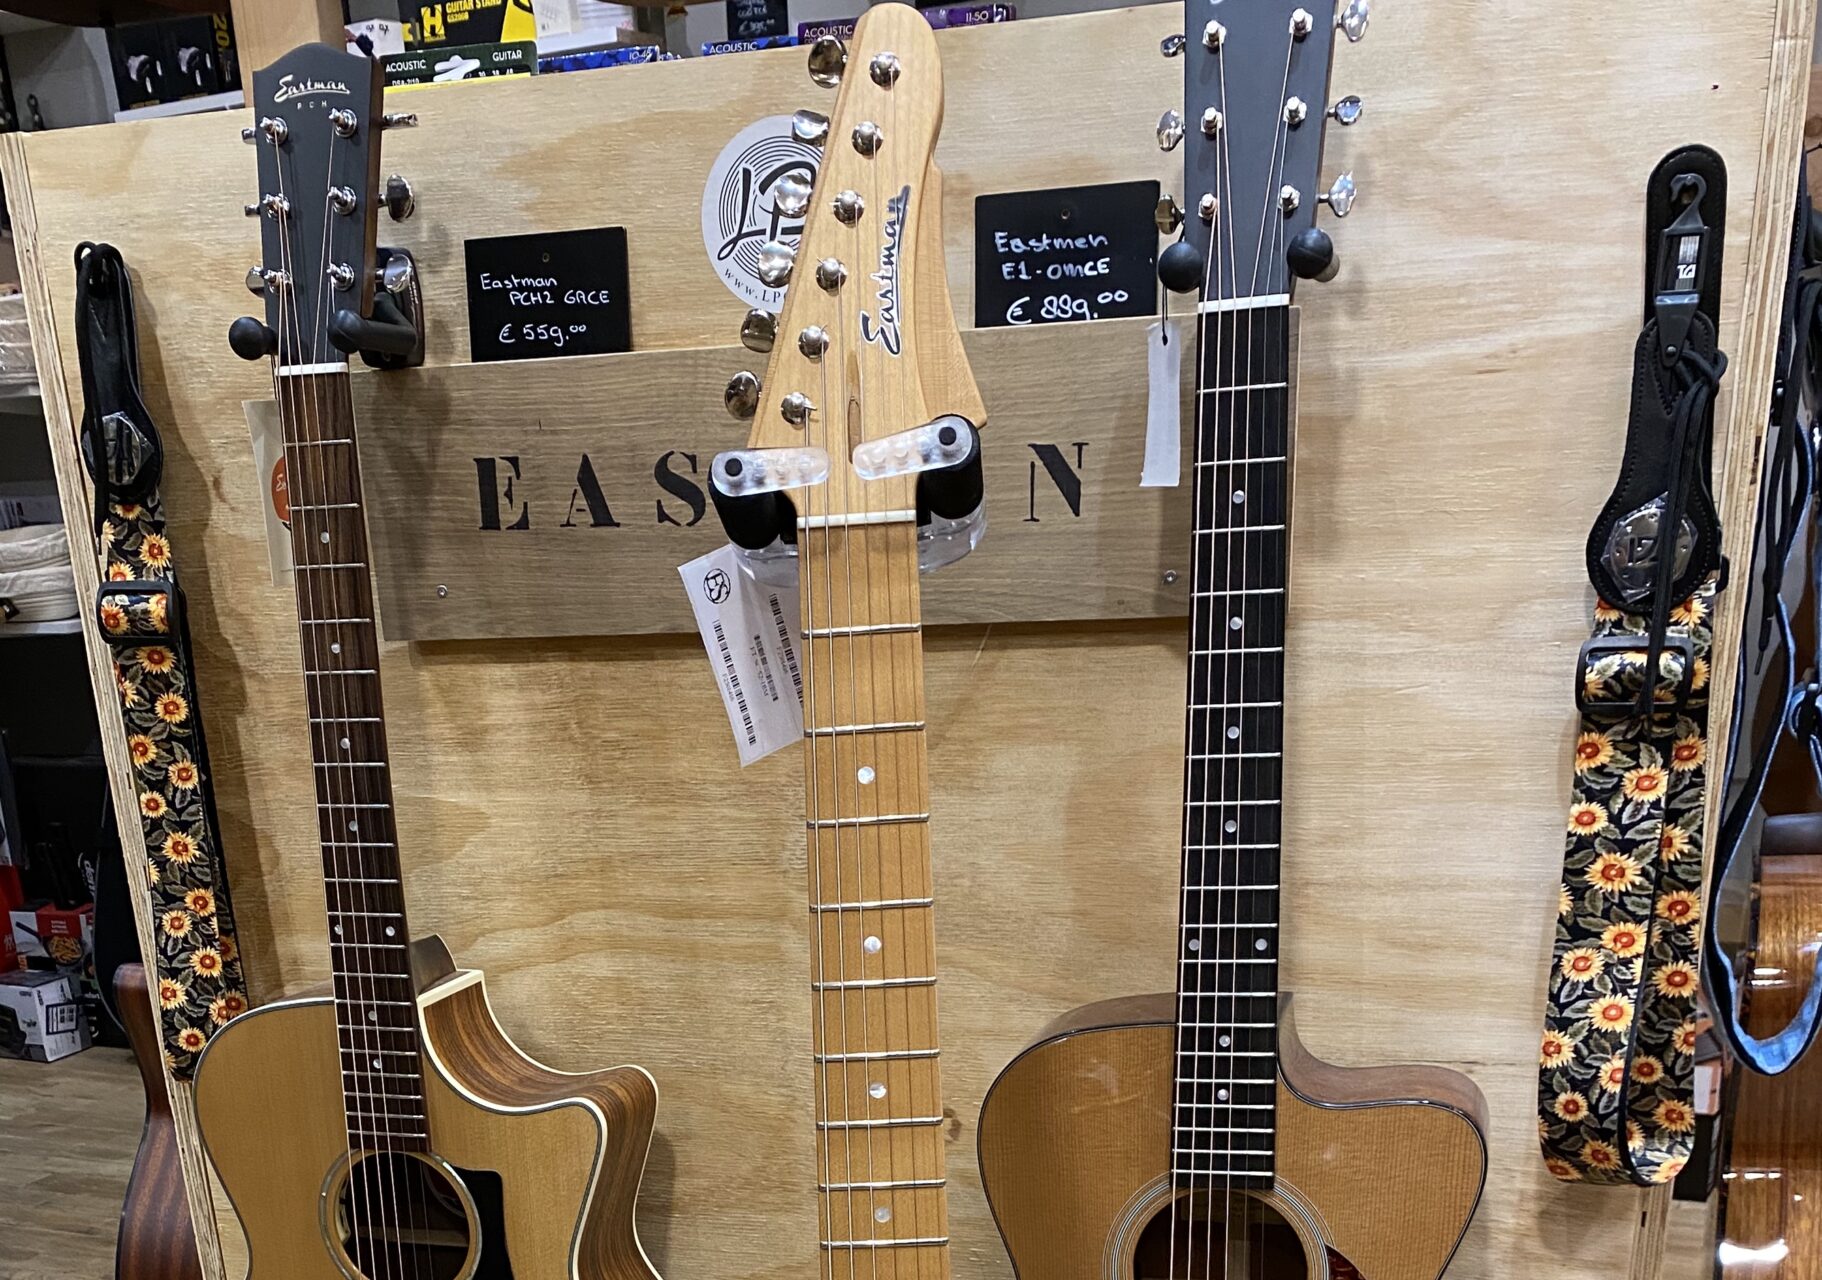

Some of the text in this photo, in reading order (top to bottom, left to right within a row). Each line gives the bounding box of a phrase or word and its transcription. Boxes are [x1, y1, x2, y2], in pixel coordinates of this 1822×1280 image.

[446, 0, 474, 13] GUITAR
[804, 24, 853, 38] ACOUSTIC
[709, 41, 758, 53] ACOUSTIC
[492, 49, 522, 62] GUITAR
[386, 59, 427, 72] ACOUSTIC
[274, 74, 350, 103] Eastman
[862, 184, 911, 356] Eastman
[480, 273, 558, 290] Eastman
[509, 290, 610, 306] PCH2 GACE
